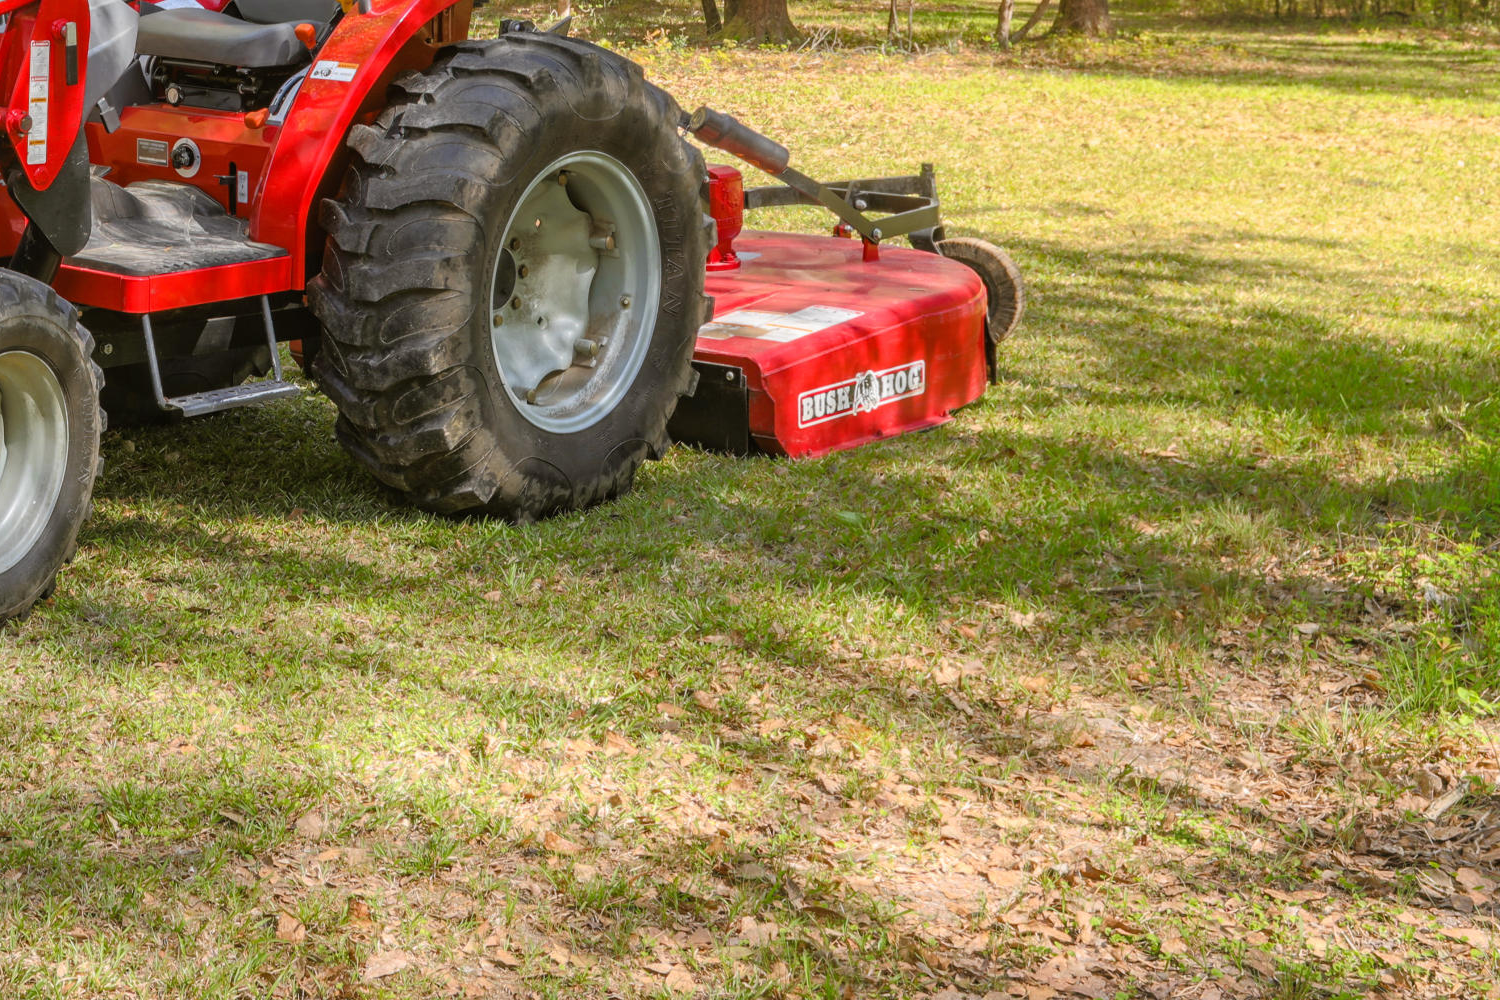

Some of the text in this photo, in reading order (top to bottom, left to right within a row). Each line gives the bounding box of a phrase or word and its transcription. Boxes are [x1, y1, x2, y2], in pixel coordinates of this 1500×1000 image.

[654, 189, 685, 317] TITAN
[802, 364, 922, 421] BUSH HOG
